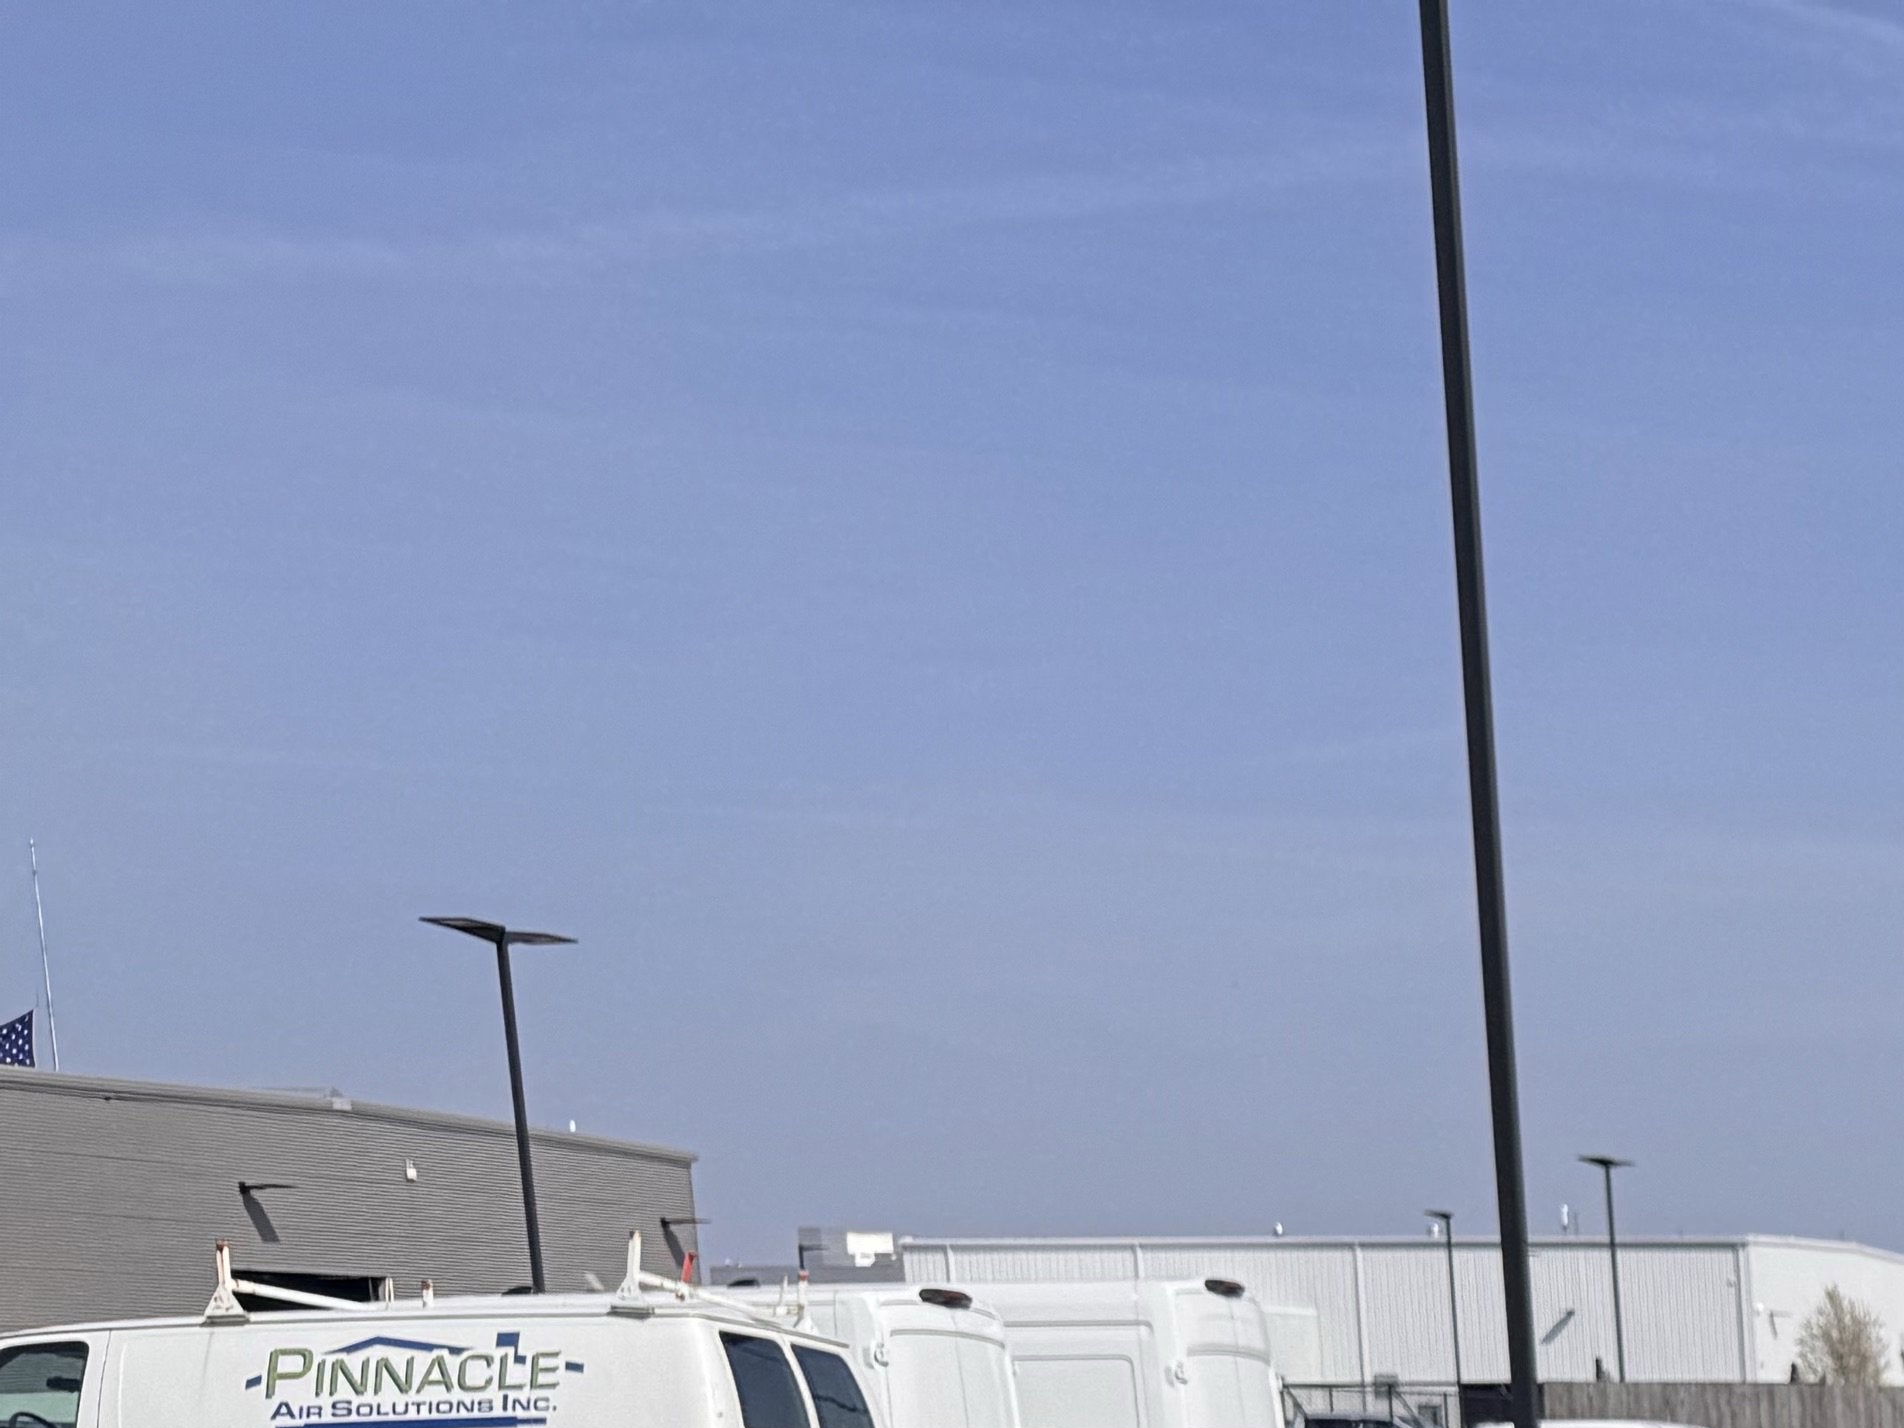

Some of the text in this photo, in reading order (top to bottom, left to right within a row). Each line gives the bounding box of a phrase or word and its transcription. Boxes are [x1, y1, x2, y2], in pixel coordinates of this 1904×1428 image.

[266, 1348, 562, 1399] PINNACLE
[271, 1394, 557, 1420] AIR SOLUTIONS INC.
